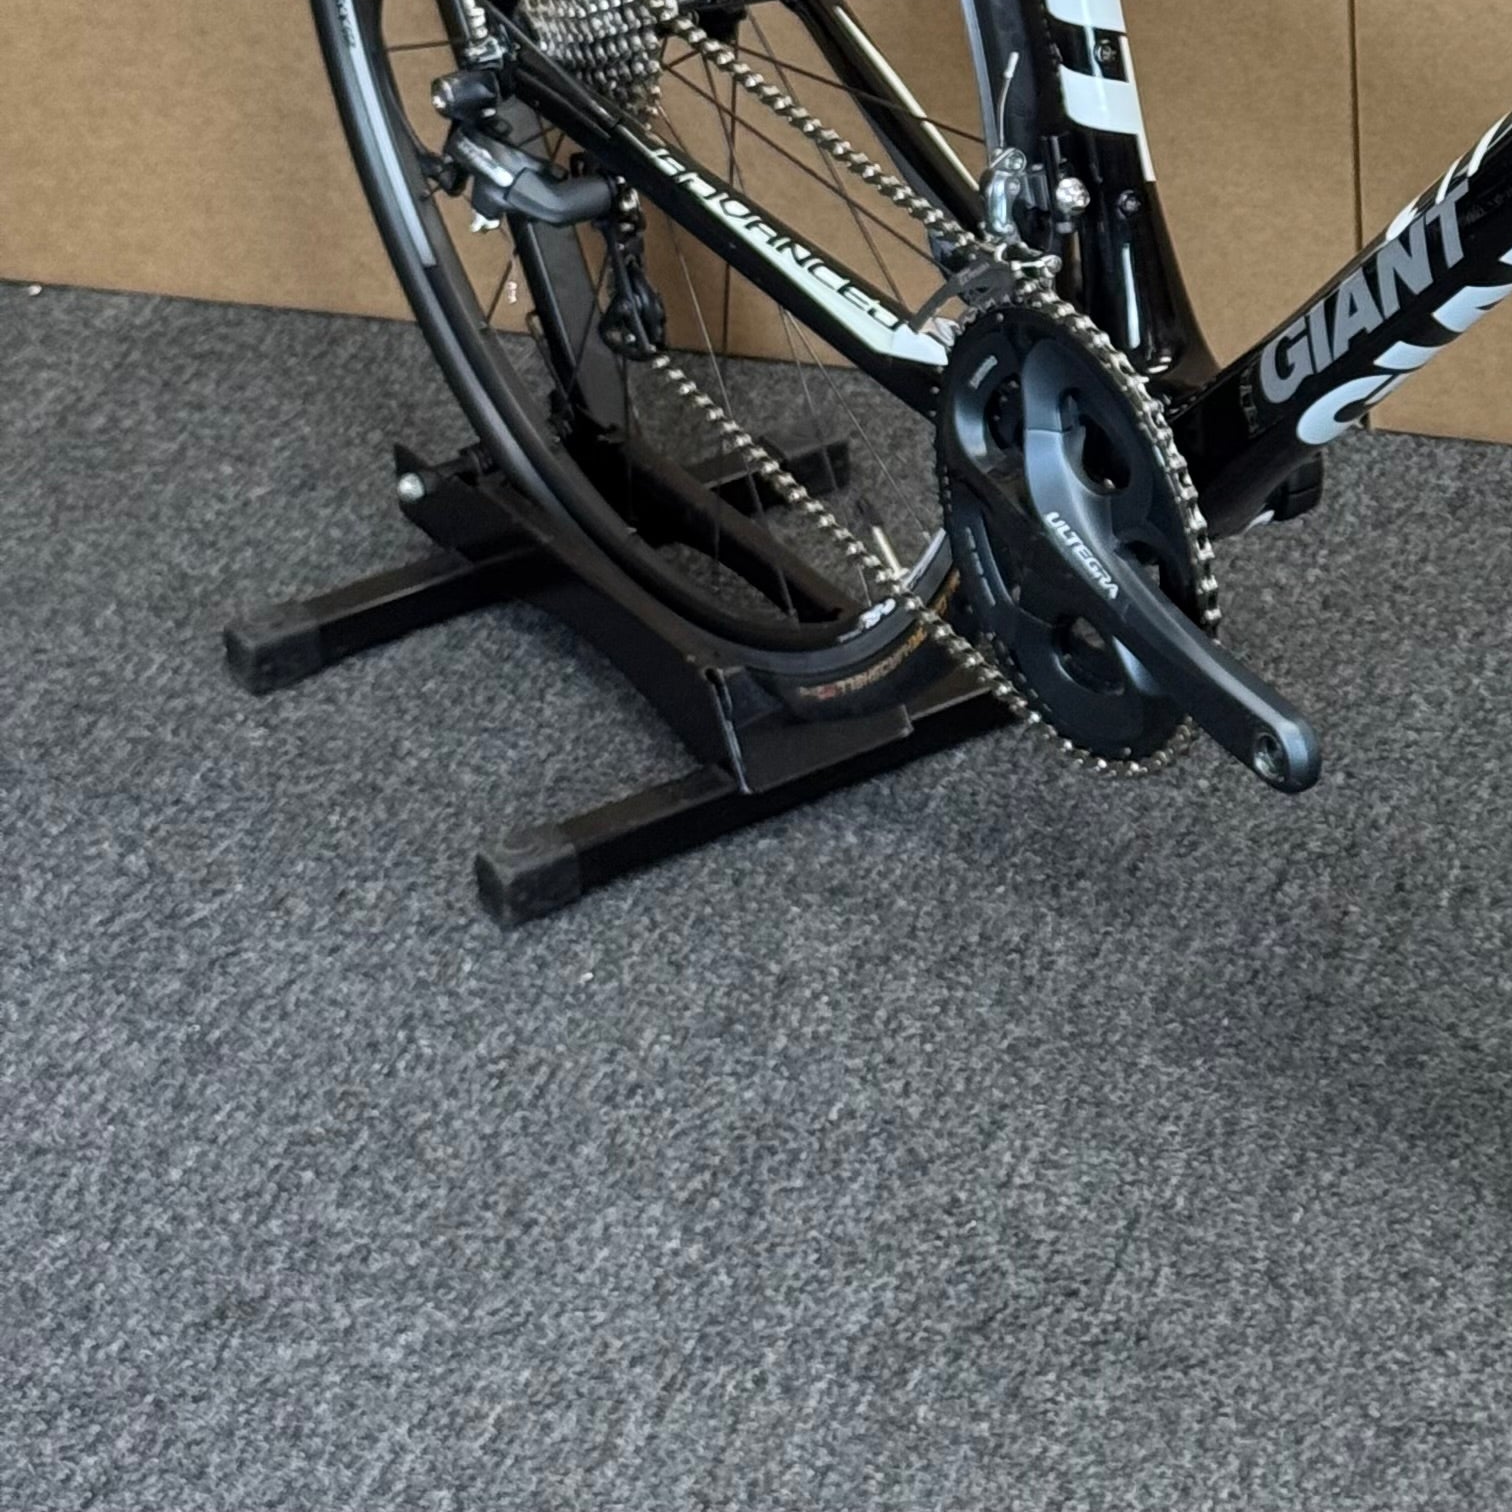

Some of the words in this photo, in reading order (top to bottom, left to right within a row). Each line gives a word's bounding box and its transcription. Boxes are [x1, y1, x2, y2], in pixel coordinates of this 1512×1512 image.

[653, 146, 900, 330] ADVANCED
[1260, 178, 1469, 405] GIANT
[1044, 512, 1118, 599] ULTEGRA
